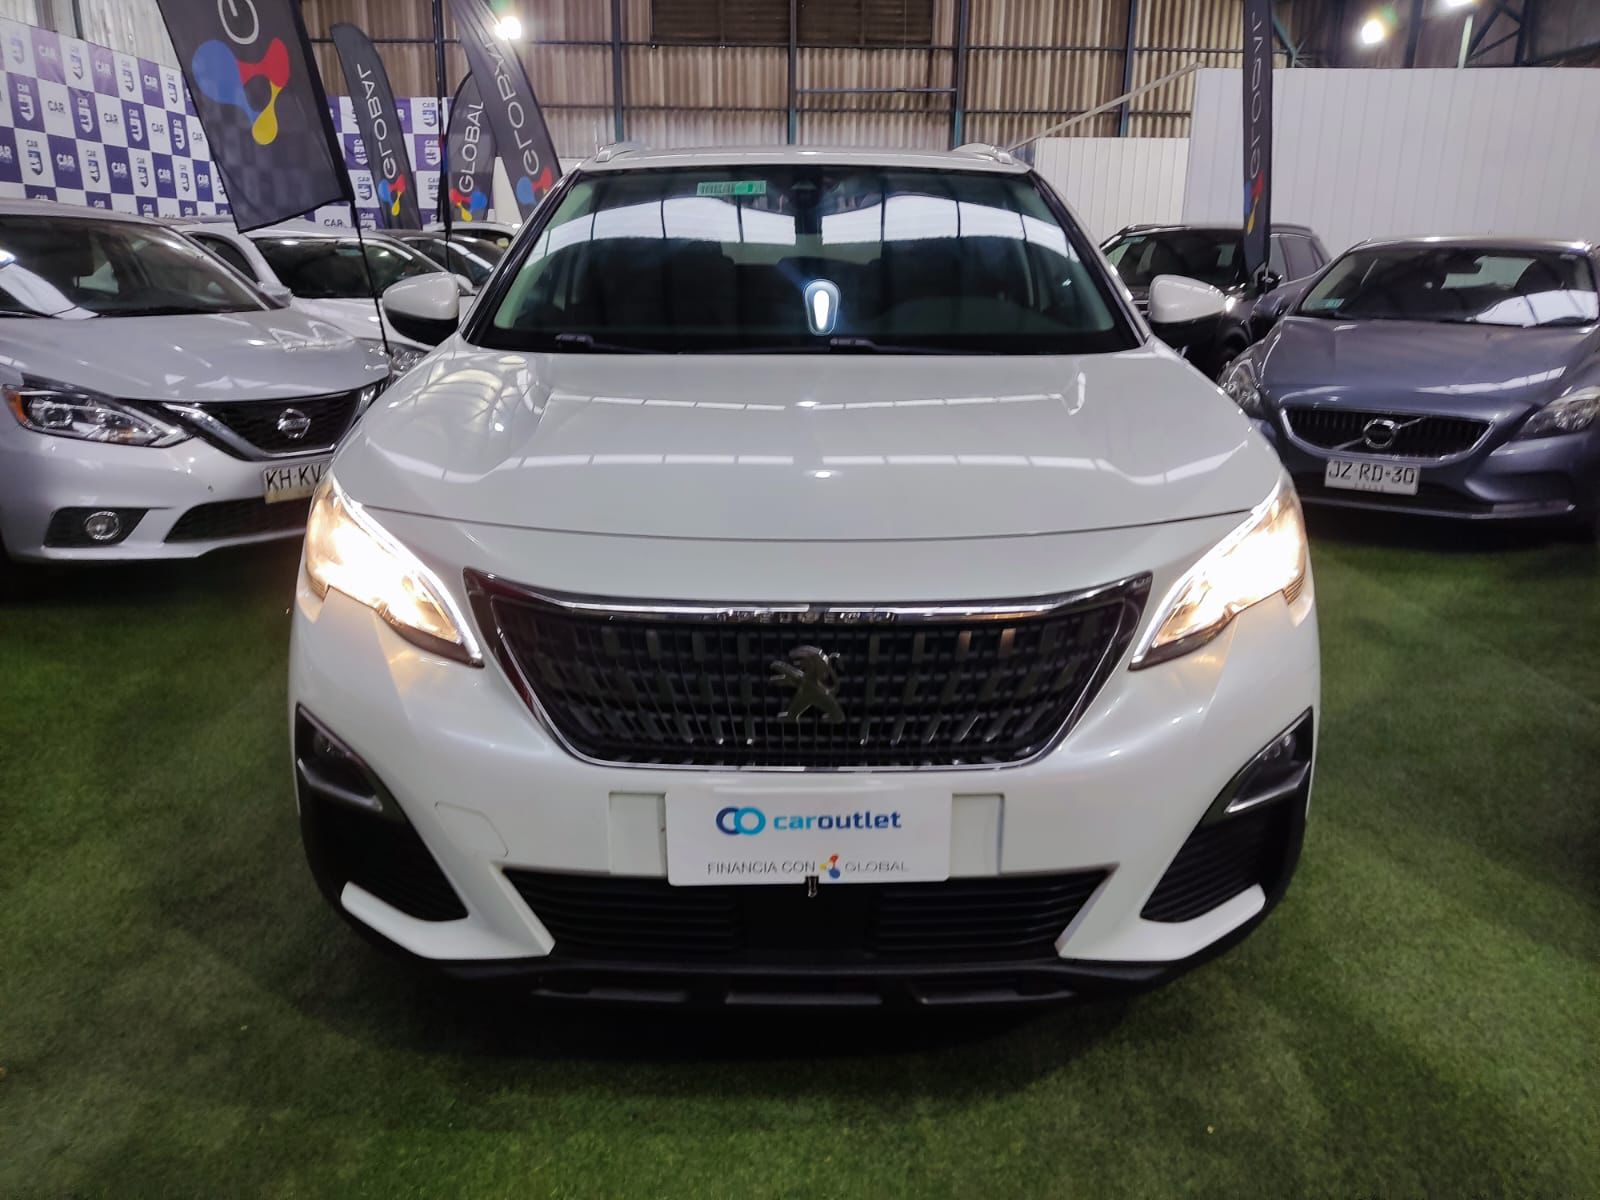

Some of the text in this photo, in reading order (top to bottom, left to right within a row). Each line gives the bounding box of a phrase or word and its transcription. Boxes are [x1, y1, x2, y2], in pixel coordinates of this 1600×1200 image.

[458, 101, 484, 193] GLOBAL
[324, 218, 343, 227] CAR
[773, 811, 902, 831] caroutlet
[707, 860, 909, 875] FINANCIA CON GLOBAL
